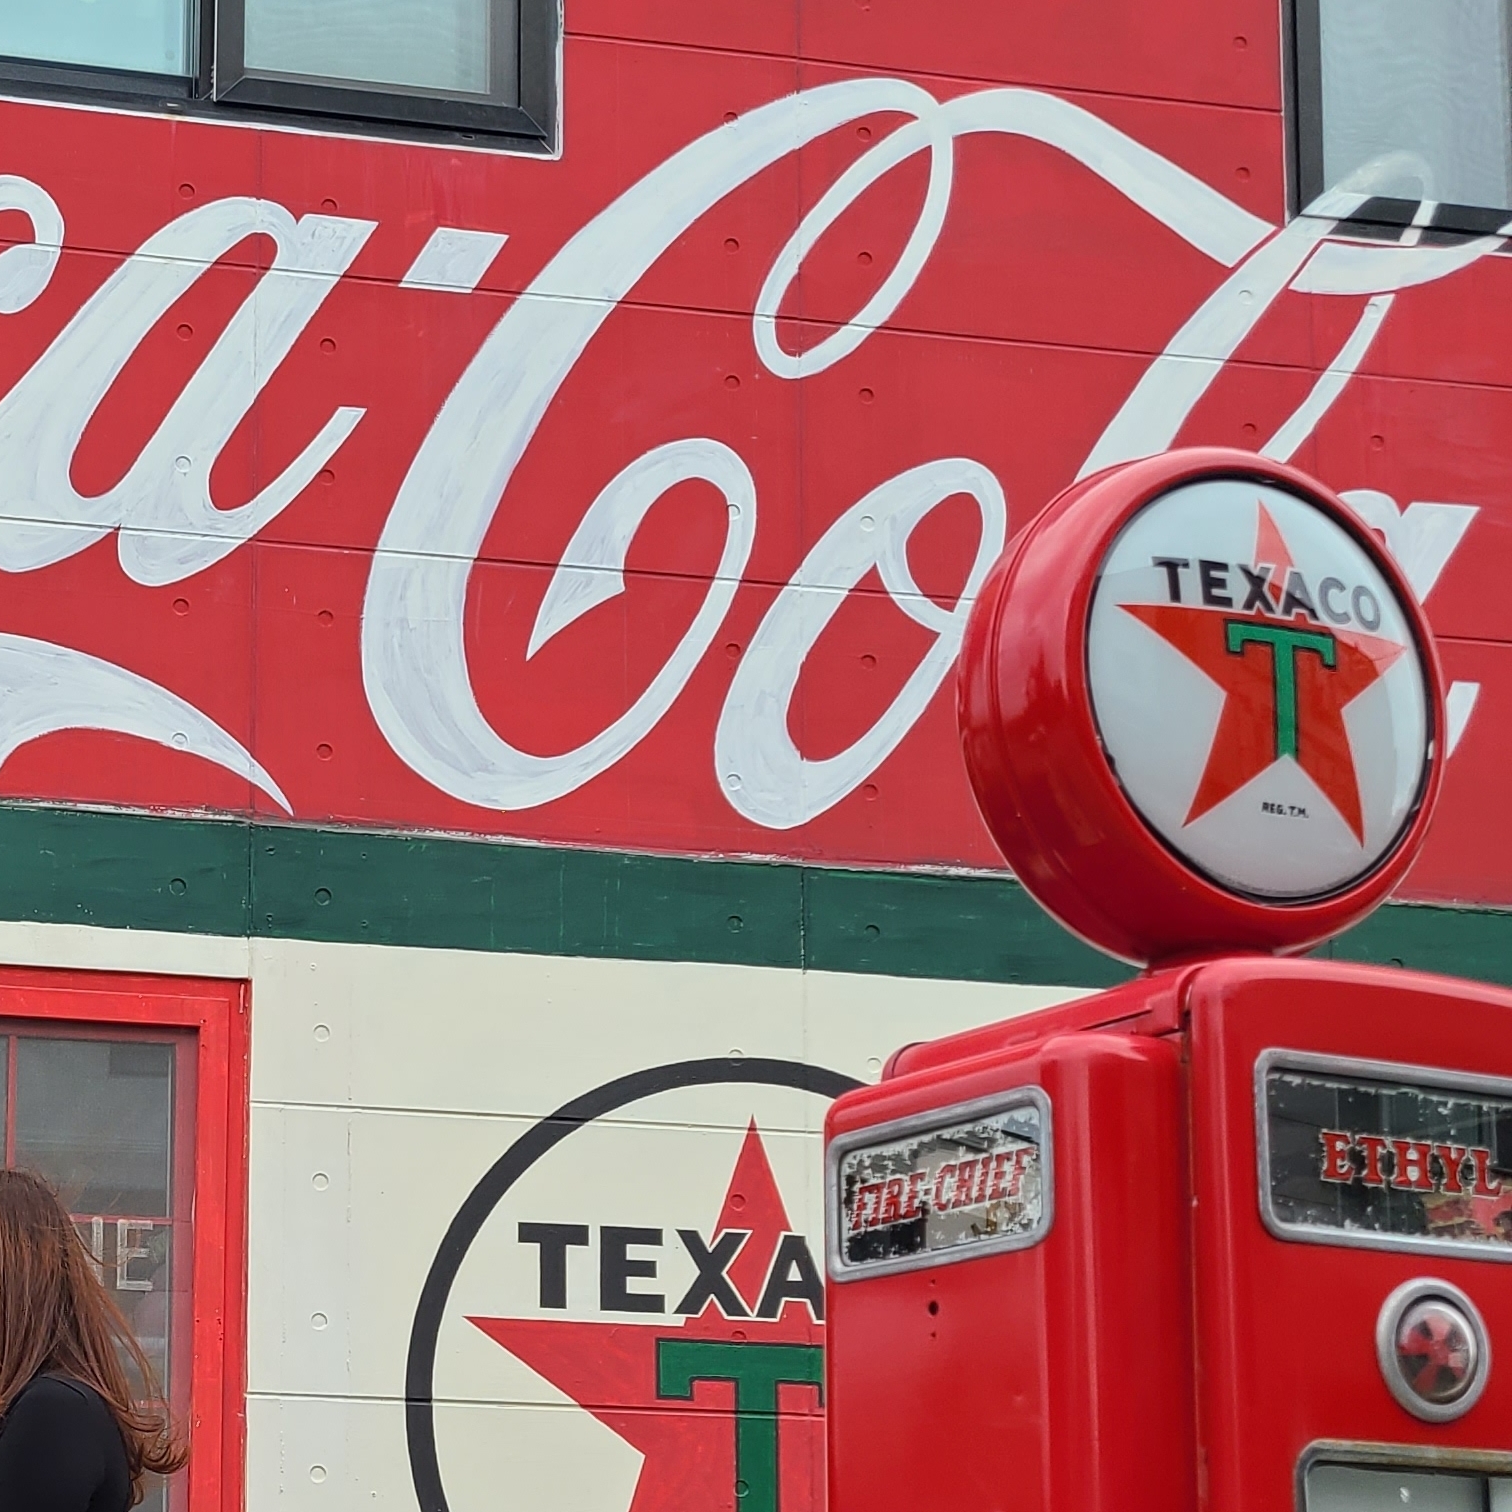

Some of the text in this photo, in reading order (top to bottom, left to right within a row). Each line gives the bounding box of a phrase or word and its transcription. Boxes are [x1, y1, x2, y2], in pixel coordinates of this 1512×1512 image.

[1152, 556, 1381, 632] TEXACO
[1223, 619, 1337, 763] T
[851, 1145, 1037, 1231] FIRE-CHIEF
[1321, 1128, 1502, 1200] ETHYL
[518, 1222, 825, 1318] TEXA
